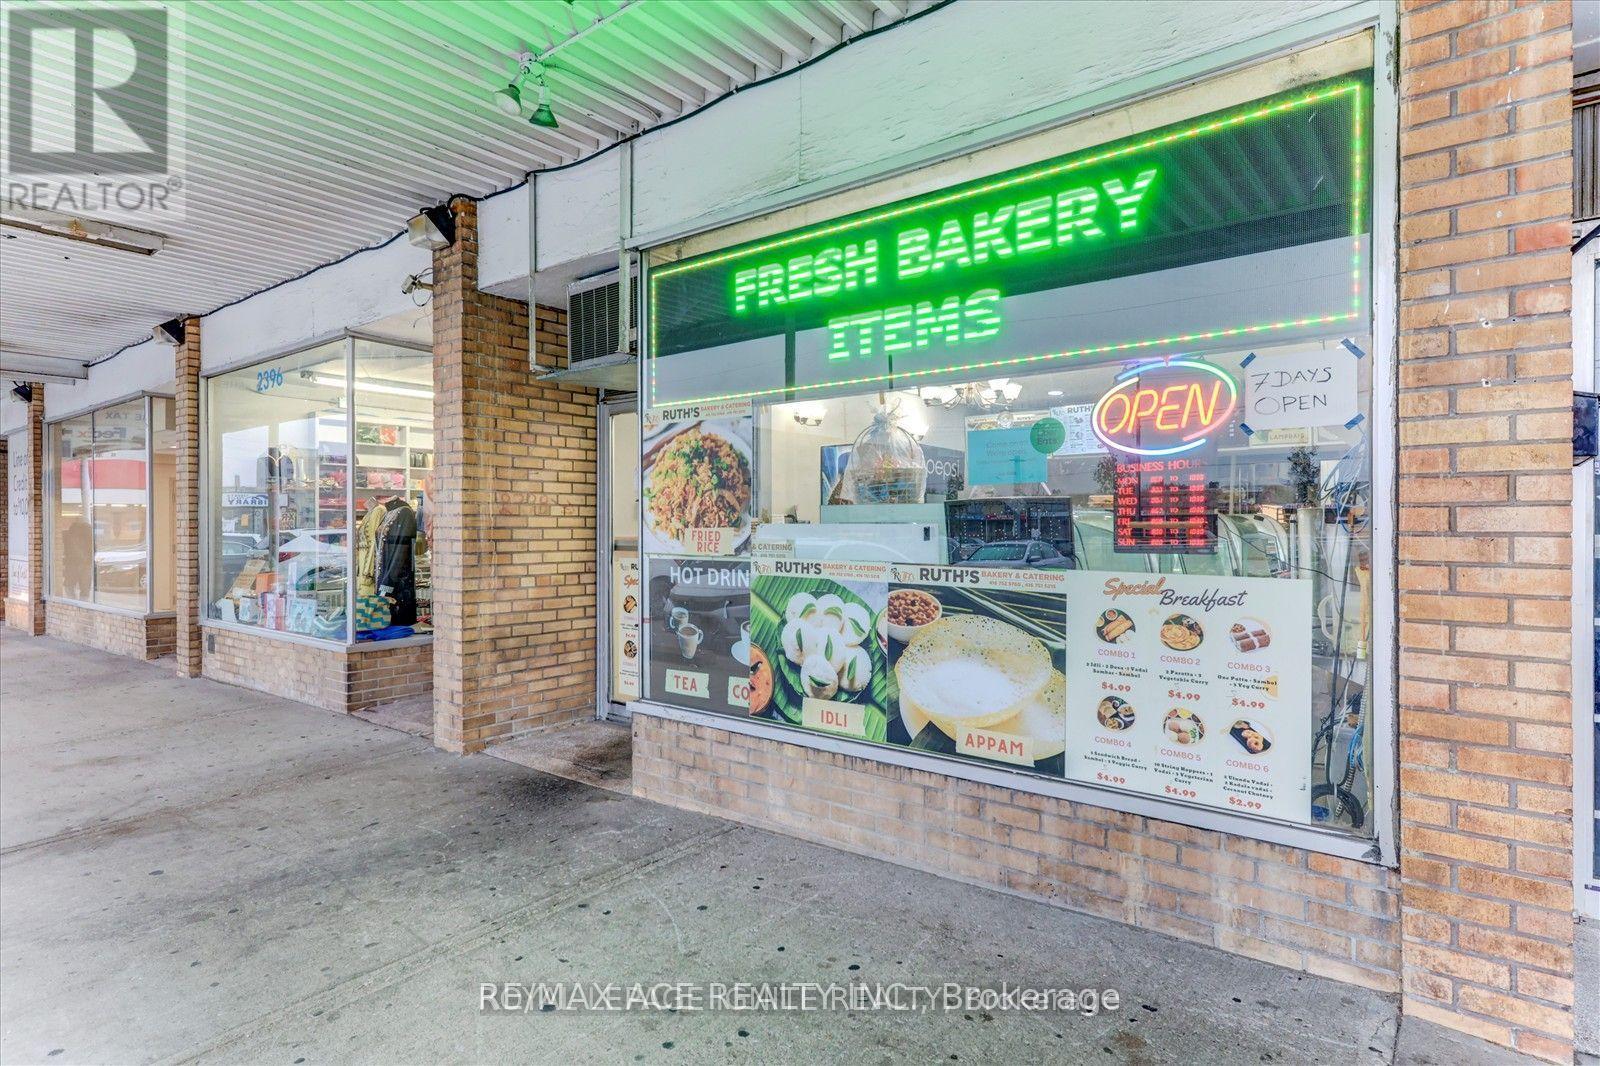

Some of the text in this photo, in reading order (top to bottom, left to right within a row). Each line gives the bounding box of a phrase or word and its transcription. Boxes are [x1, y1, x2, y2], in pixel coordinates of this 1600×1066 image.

[734, 169, 1157, 313] FRESH BAKERY
[828, 287, 1002, 361] ITEMS
[257, 367, 283, 392] 2396
[1251, 366, 1333, 393] 7 DAYS
[1067, 405, 1094, 413] RUTH'
[1100, 380, 1223, 434] OPEN
[1254, 394, 1327, 415] OPEN
[662, 406, 700, 420] RUTH'S
[1116, 459, 1201, 473] BUSINESS HOUR
[691, 530, 721, 543] FRIED
[696, 541, 720, 553] RICE
[758, 543, 793, 551] CATERING
[775, 561, 822, 575] RUTH'S
[670, 566, 750, 587] HOT DRIN
[919, 567, 980, 585] RUTH'S
[981, 570, 1013, 579] BAKERY
[1022, 572, 1065, 582] CATERING
[1103, 577, 1166, 600] Special
[1159, 588, 1248, 612] Breakfast
[1098, 649, 1130, 658] COMBO
[1160, 655, 1200, 666] COMBO 2
[1227, 661, 1271, 673] COMBO 3
[674, 675, 698, 692] TEA
[1159, 674, 1189, 682] Vegetable
[732, 684, 750, 700] CO
[1101, 681, 1131, 692] $4.99
[1168, 689, 1200, 701] $4.99
[1232, 697, 1265, 709] $4.99
[820, 711, 848, 728] IDLI
[965, 733, 1025, 758] APPAM
[1095, 736, 1125, 747] COMBO
[1160, 748, 1201, 762] COMBO 5
[1131, 763, 1147, 771] Curry
[1161, 763, 1180, 771] String
[1181, 766, 1205, 775] Hoppers
[1226, 759, 1269, 773] COMBO 6
[1097, 772, 1126, 785] $4.99
[1165, 785, 1196, 797] $4.99
[1223, 786, 1274, 800] Coconut Chutney
[1228, 796, 1262, 809] $2.99
